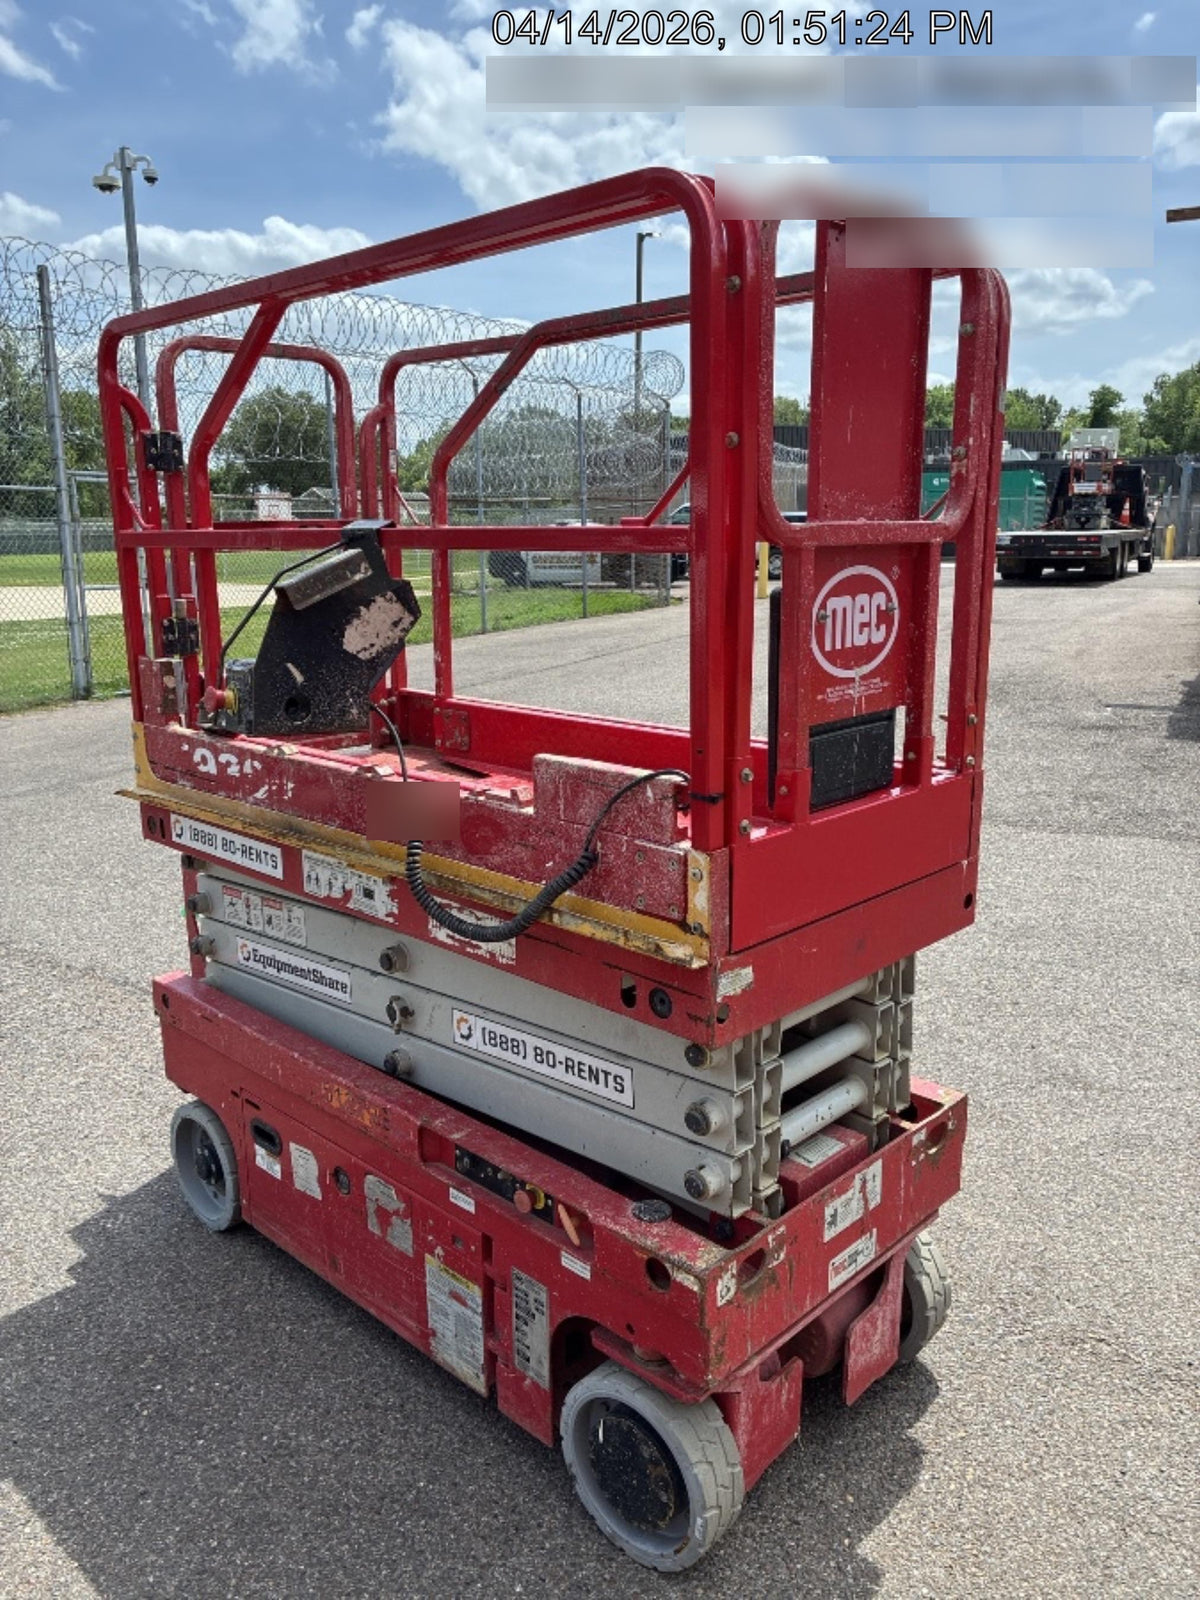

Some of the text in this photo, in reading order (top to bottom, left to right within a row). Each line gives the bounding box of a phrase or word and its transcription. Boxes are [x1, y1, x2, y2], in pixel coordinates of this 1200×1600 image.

[188, 824, 279, 870] (888) 80-RENTS
[251, 948, 348, 994] EquipmentShare
[481, 1027, 626, 1095] (888) 80-RENTS
